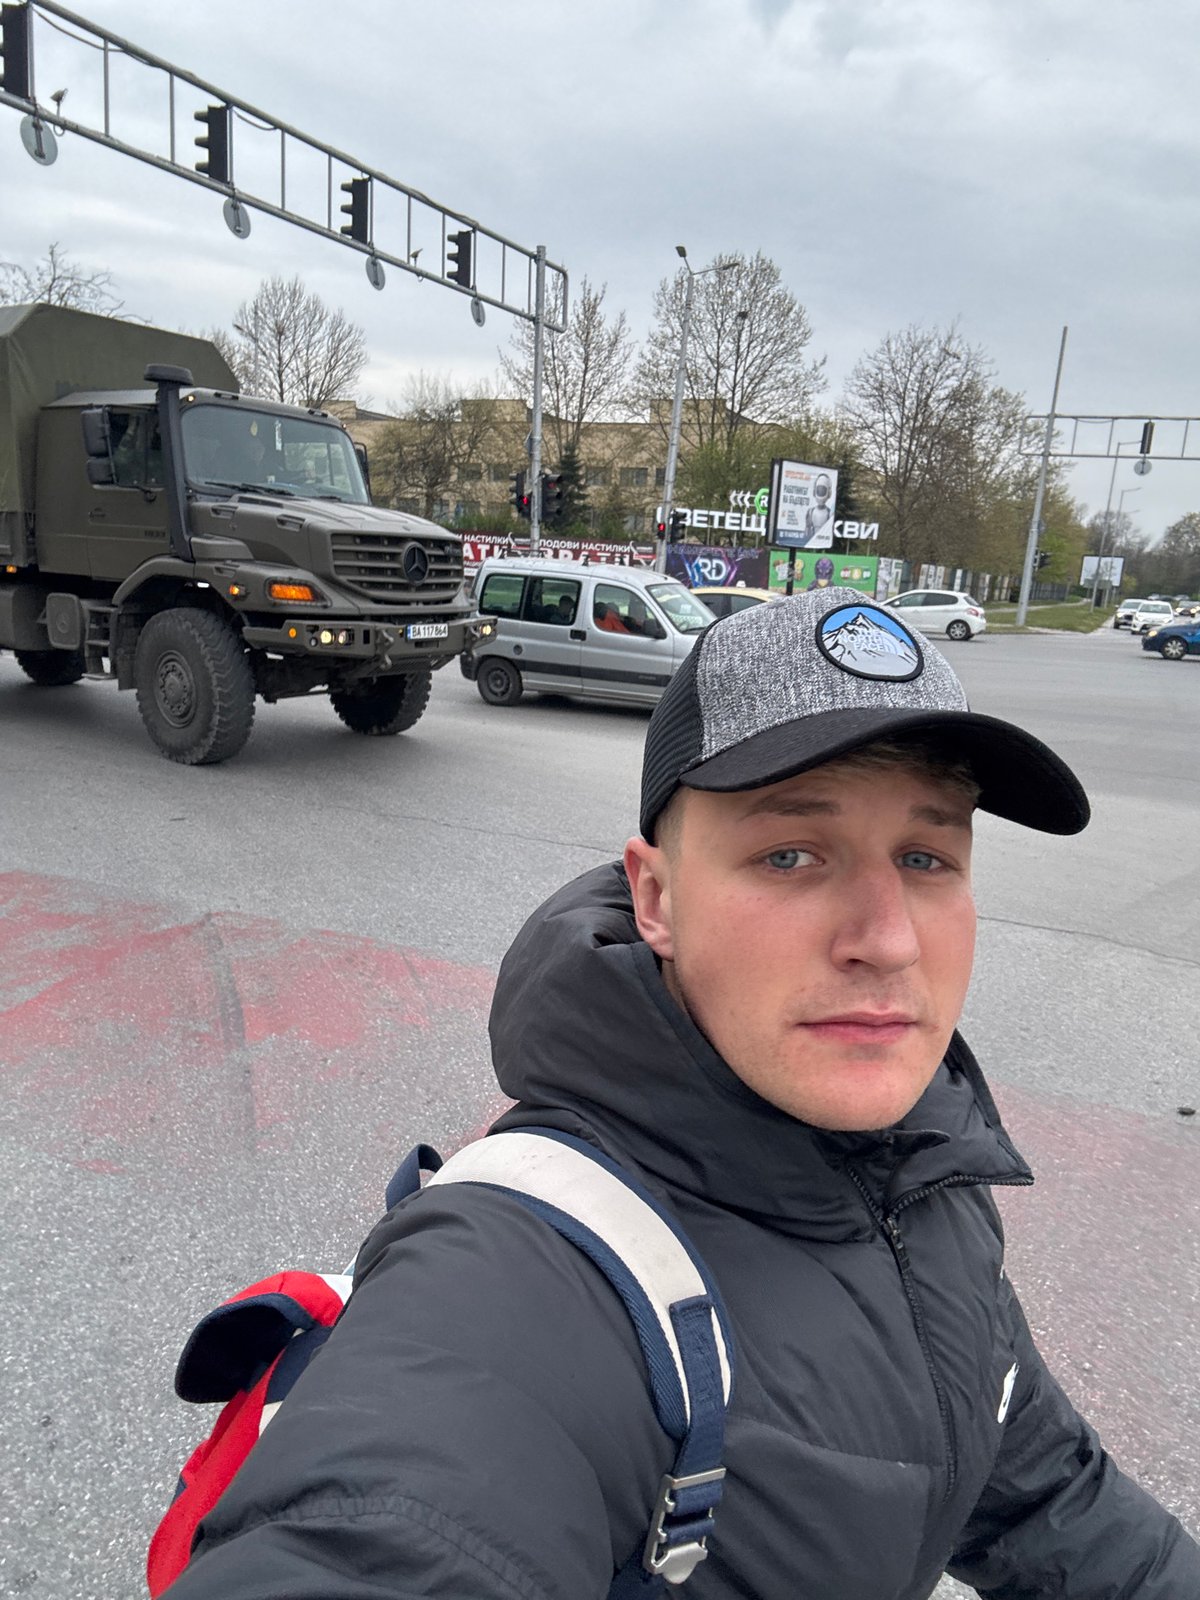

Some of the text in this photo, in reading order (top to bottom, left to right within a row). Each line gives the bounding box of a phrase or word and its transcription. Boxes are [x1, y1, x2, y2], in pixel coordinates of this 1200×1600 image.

[464, 534, 509, 544] НАСТИЛКИ
[540, 539, 580, 550] ПОДОВИ
[581, 542, 631, 553] НАСТИЛКИ
